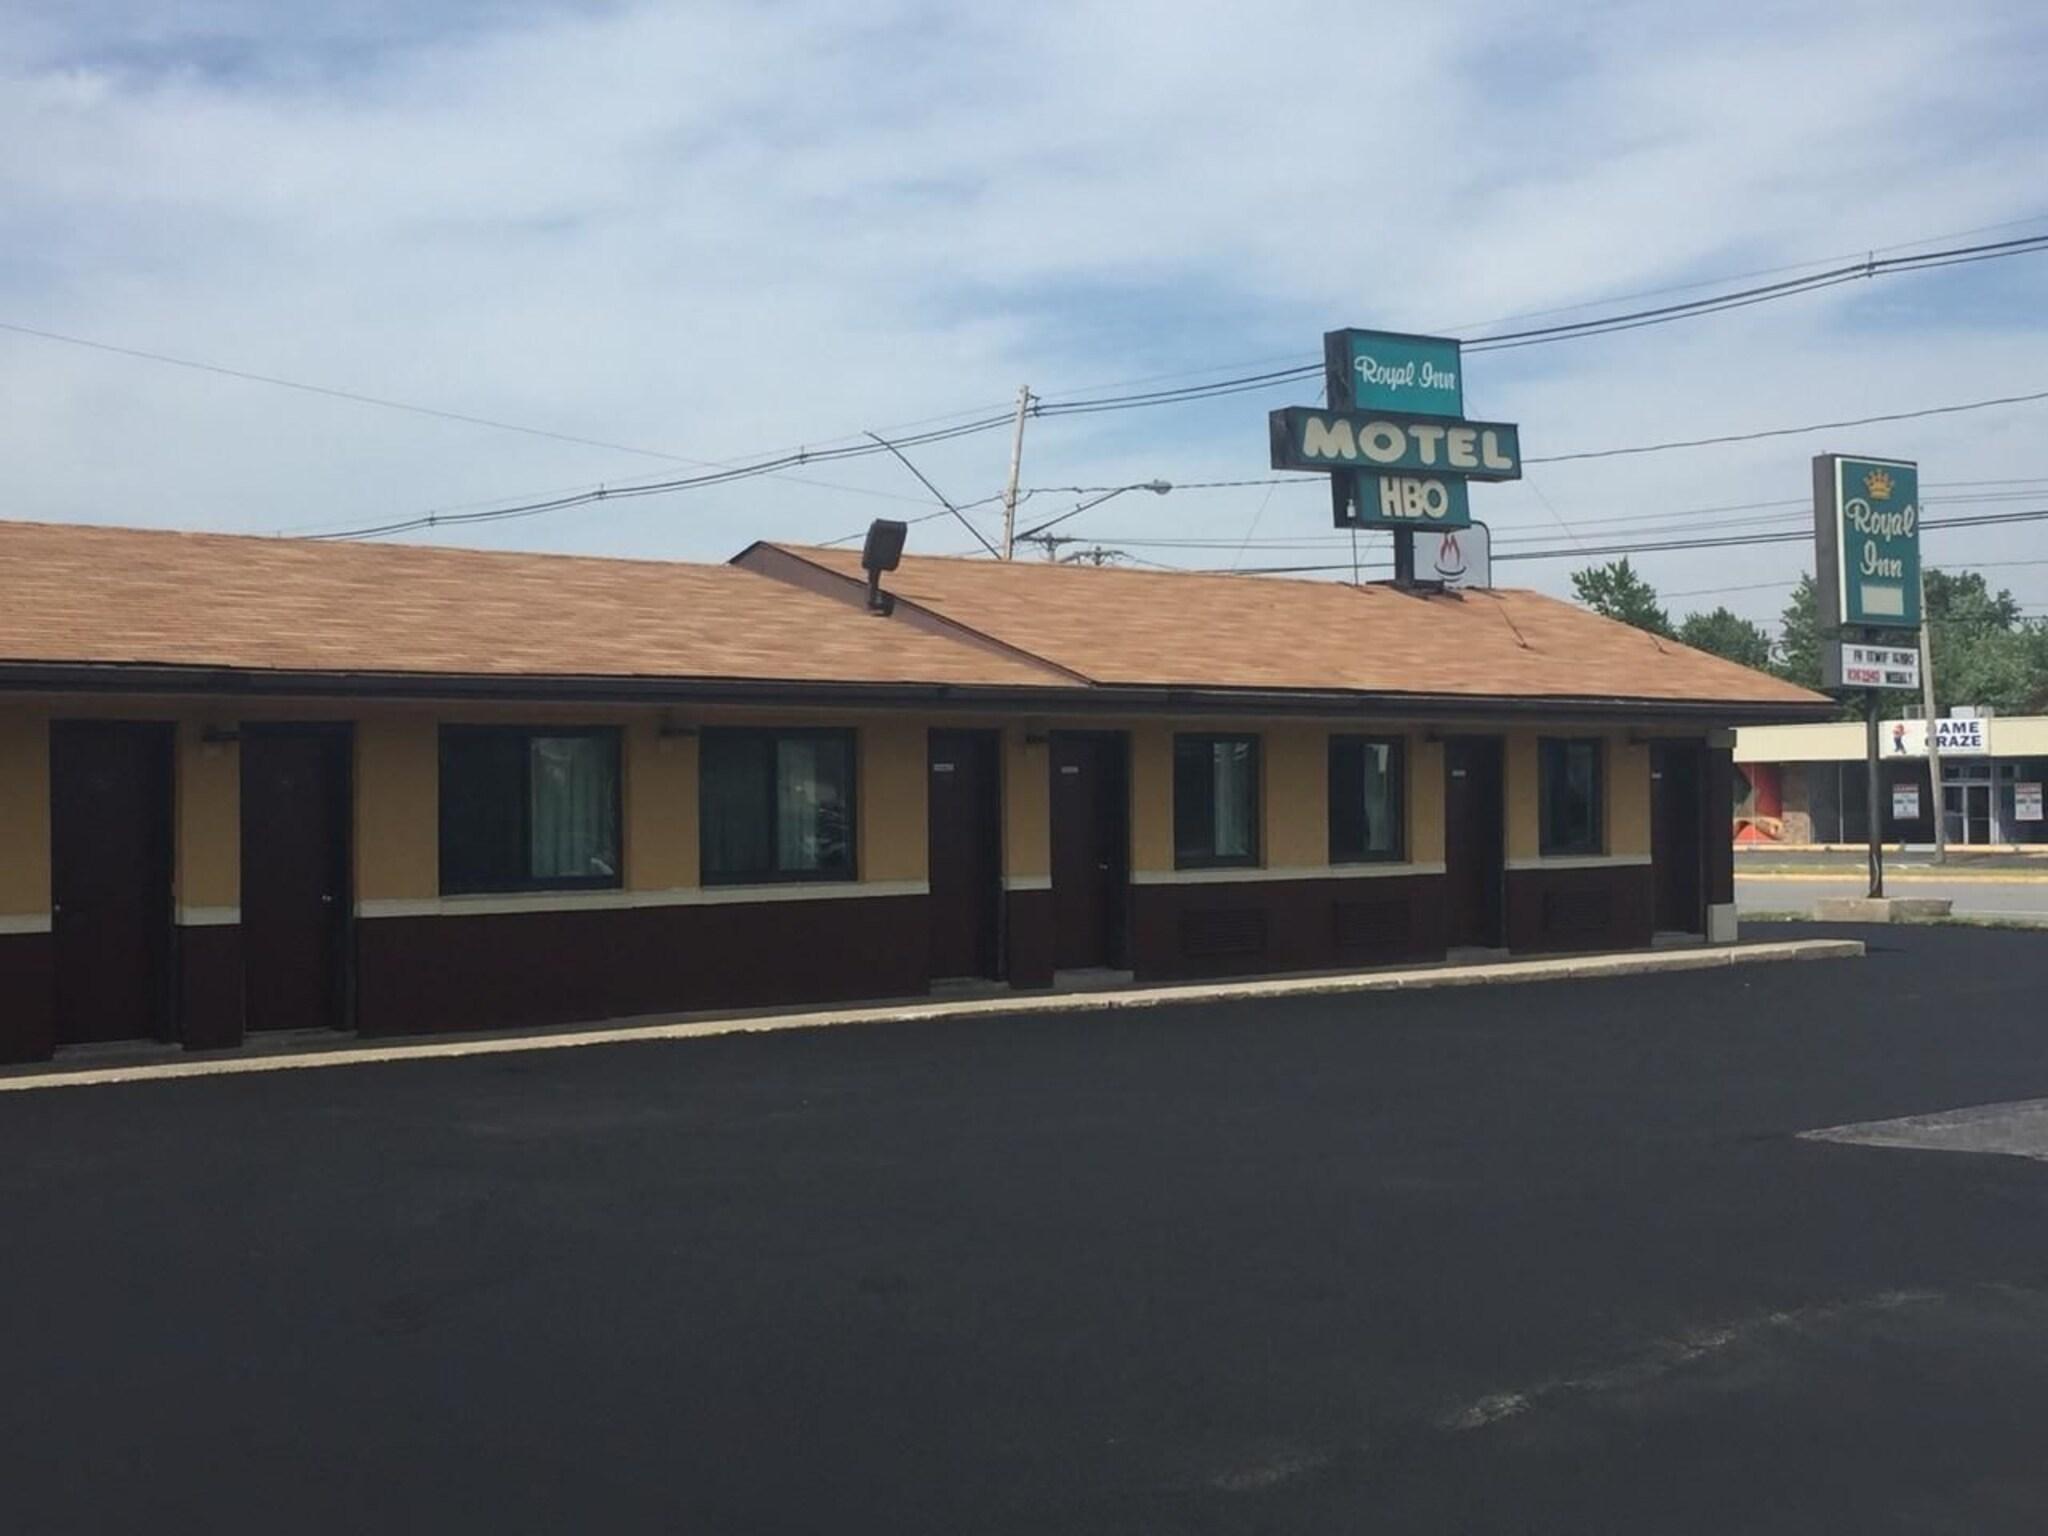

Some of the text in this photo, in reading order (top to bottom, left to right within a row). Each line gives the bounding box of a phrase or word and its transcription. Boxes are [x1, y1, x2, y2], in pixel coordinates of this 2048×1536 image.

[1354, 355, 1456, 391] Royal Inn
[1303, 416, 1513, 469] MOTEL
[1379, 476, 1448, 518] HBO
[1845, 498, 1914, 542] Royal
[1860, 540, 1902, 577] Inn
[1926, 721, 1980, 734] AME
